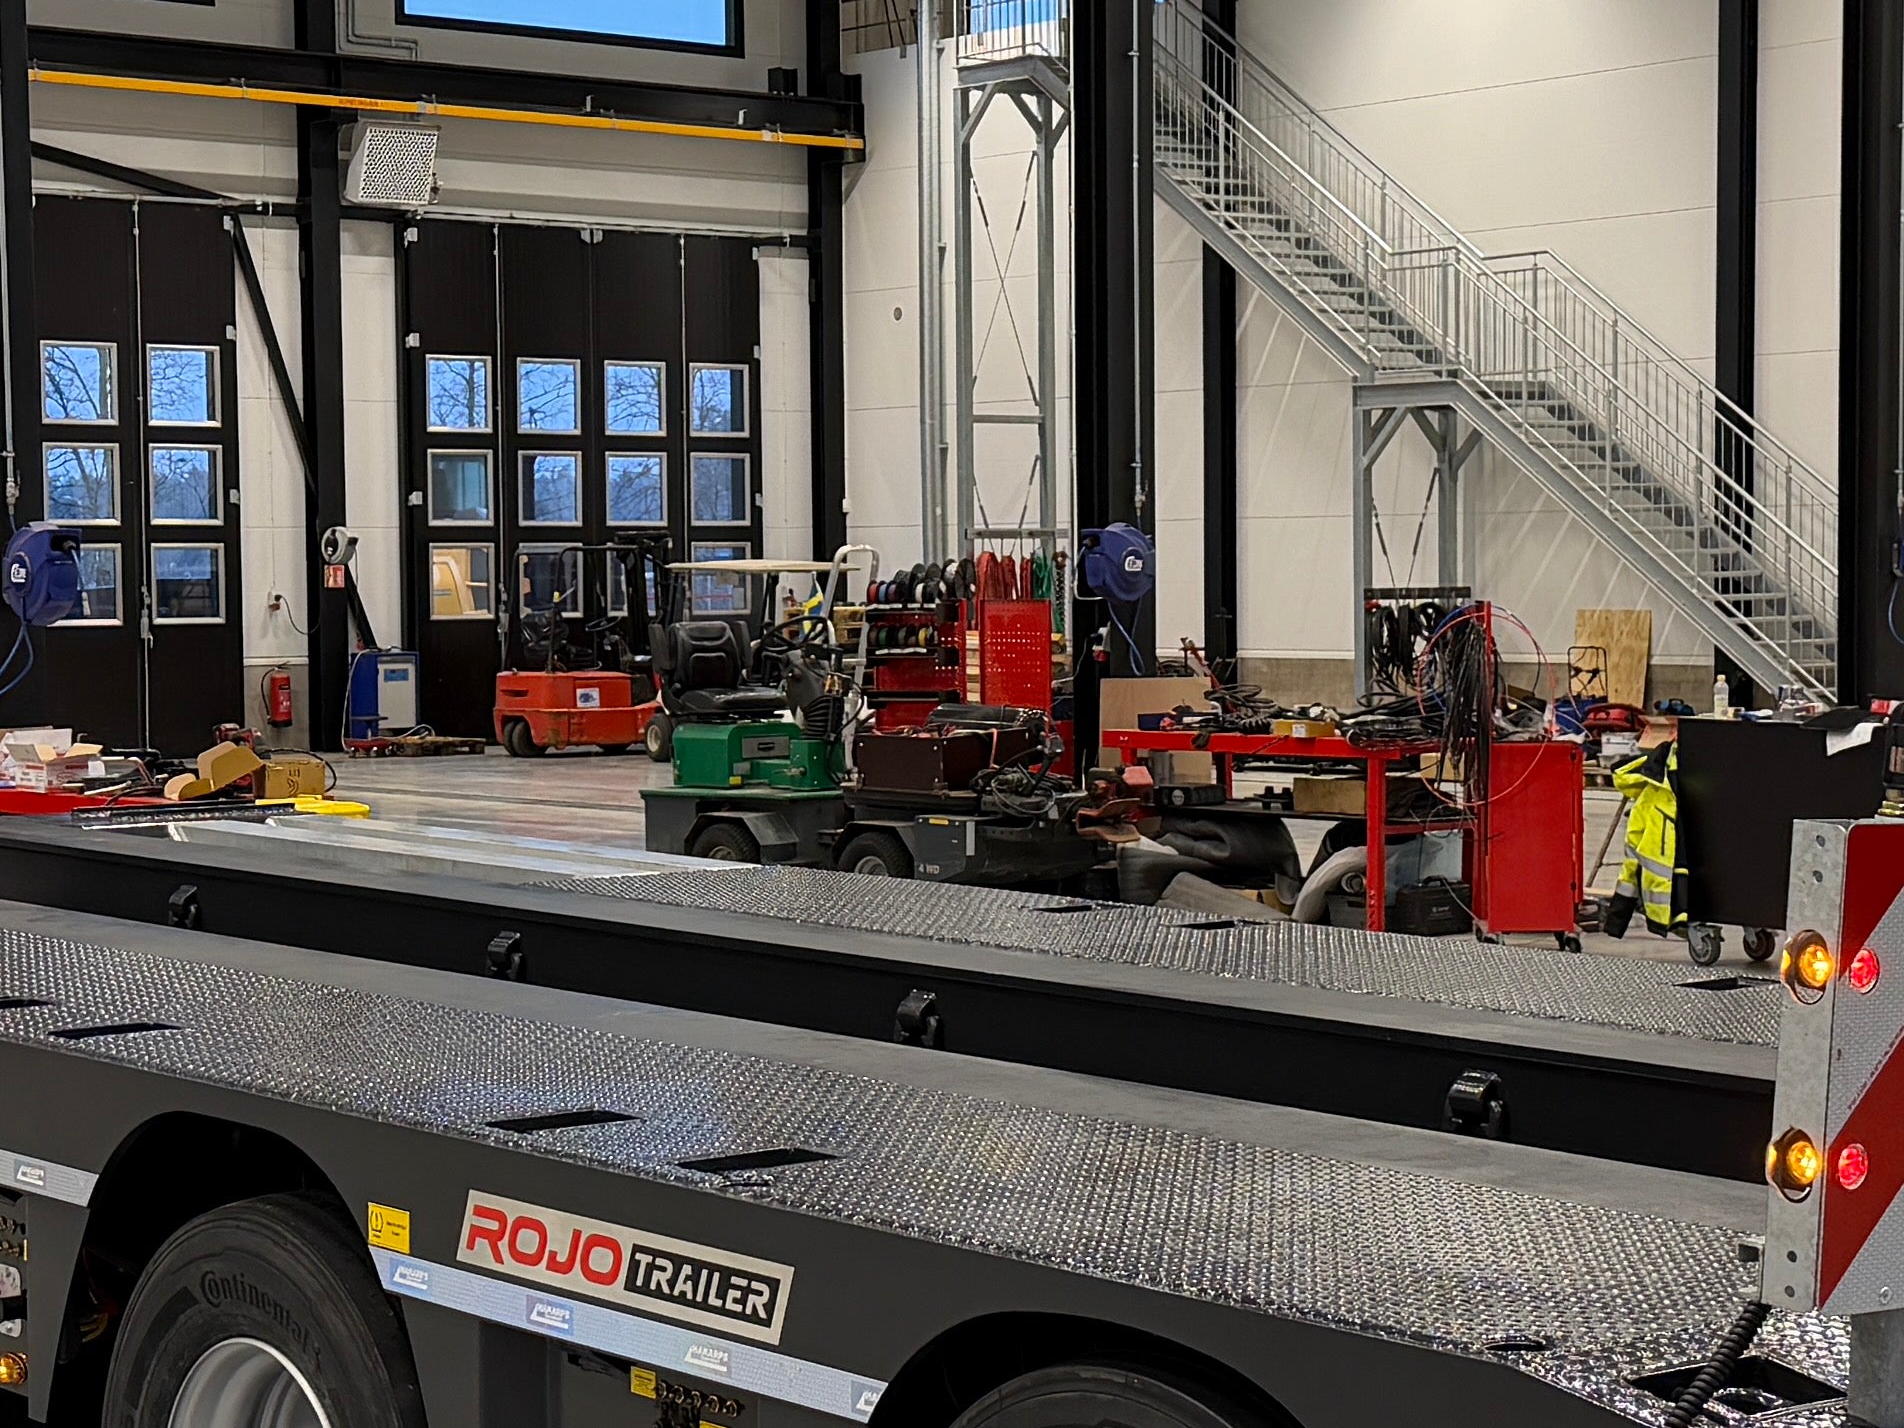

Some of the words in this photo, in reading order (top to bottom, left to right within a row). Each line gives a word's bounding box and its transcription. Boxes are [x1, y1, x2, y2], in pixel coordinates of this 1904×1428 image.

[200, 1270, 308, 1353] Continental
[465, 1203, 624, 1287] ROJO
[634, 1251, 771, 1320] TRAILER
